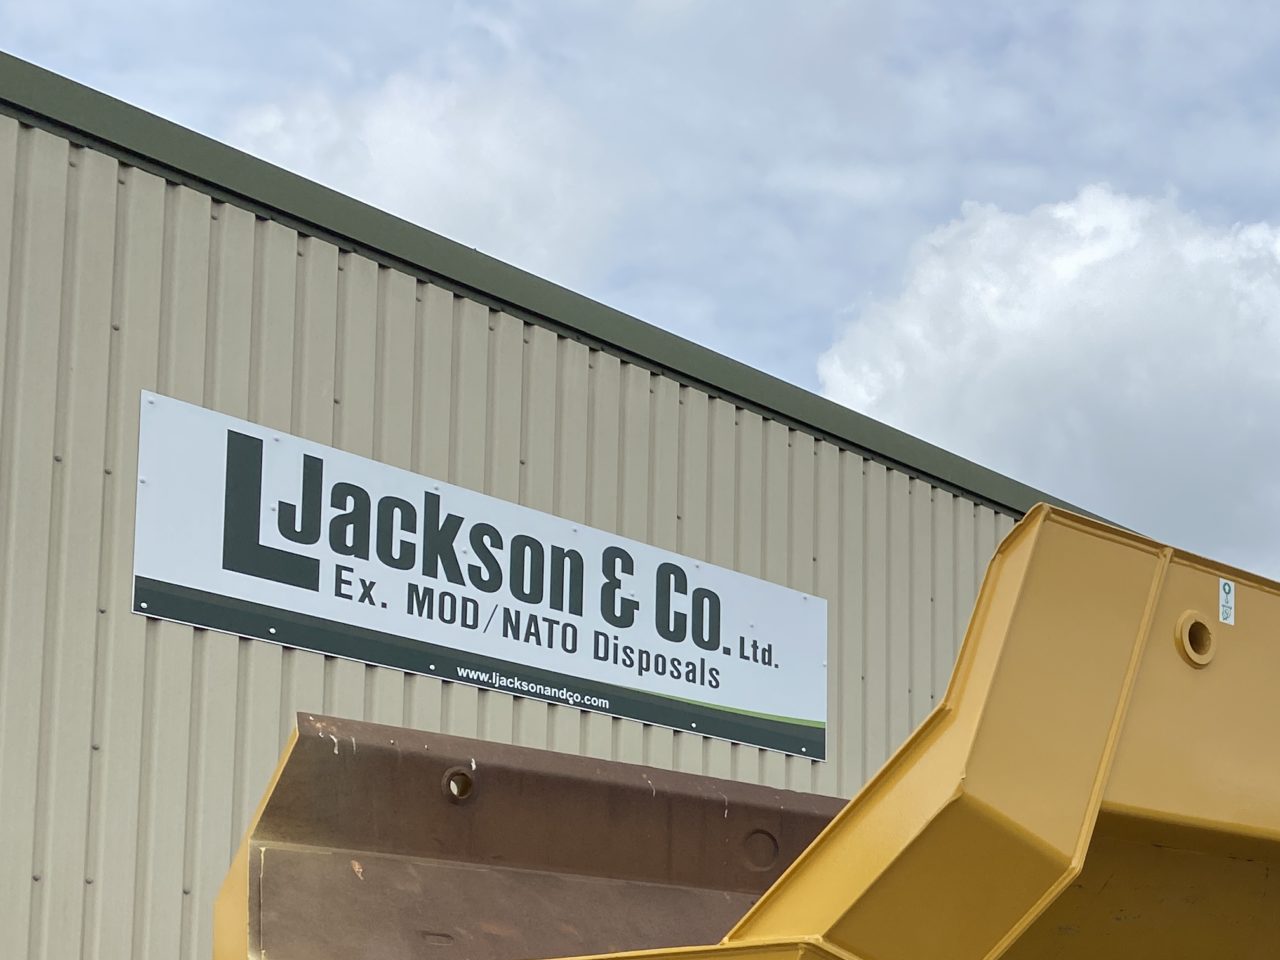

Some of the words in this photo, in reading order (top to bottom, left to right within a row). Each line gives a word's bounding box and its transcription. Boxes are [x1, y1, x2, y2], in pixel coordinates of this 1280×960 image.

[334, 564, 387, 608] Ex.
[407, 582, 578, 654] MOD/NATO
[593, 630, 720, 689] Disposals
[600, 546, 639, 628] &
[655, 562, 731, 655] Co.
[739, 636, 779, 668] Ltd.
[456, 666, 610, 709] www.ljacksonandco.com
